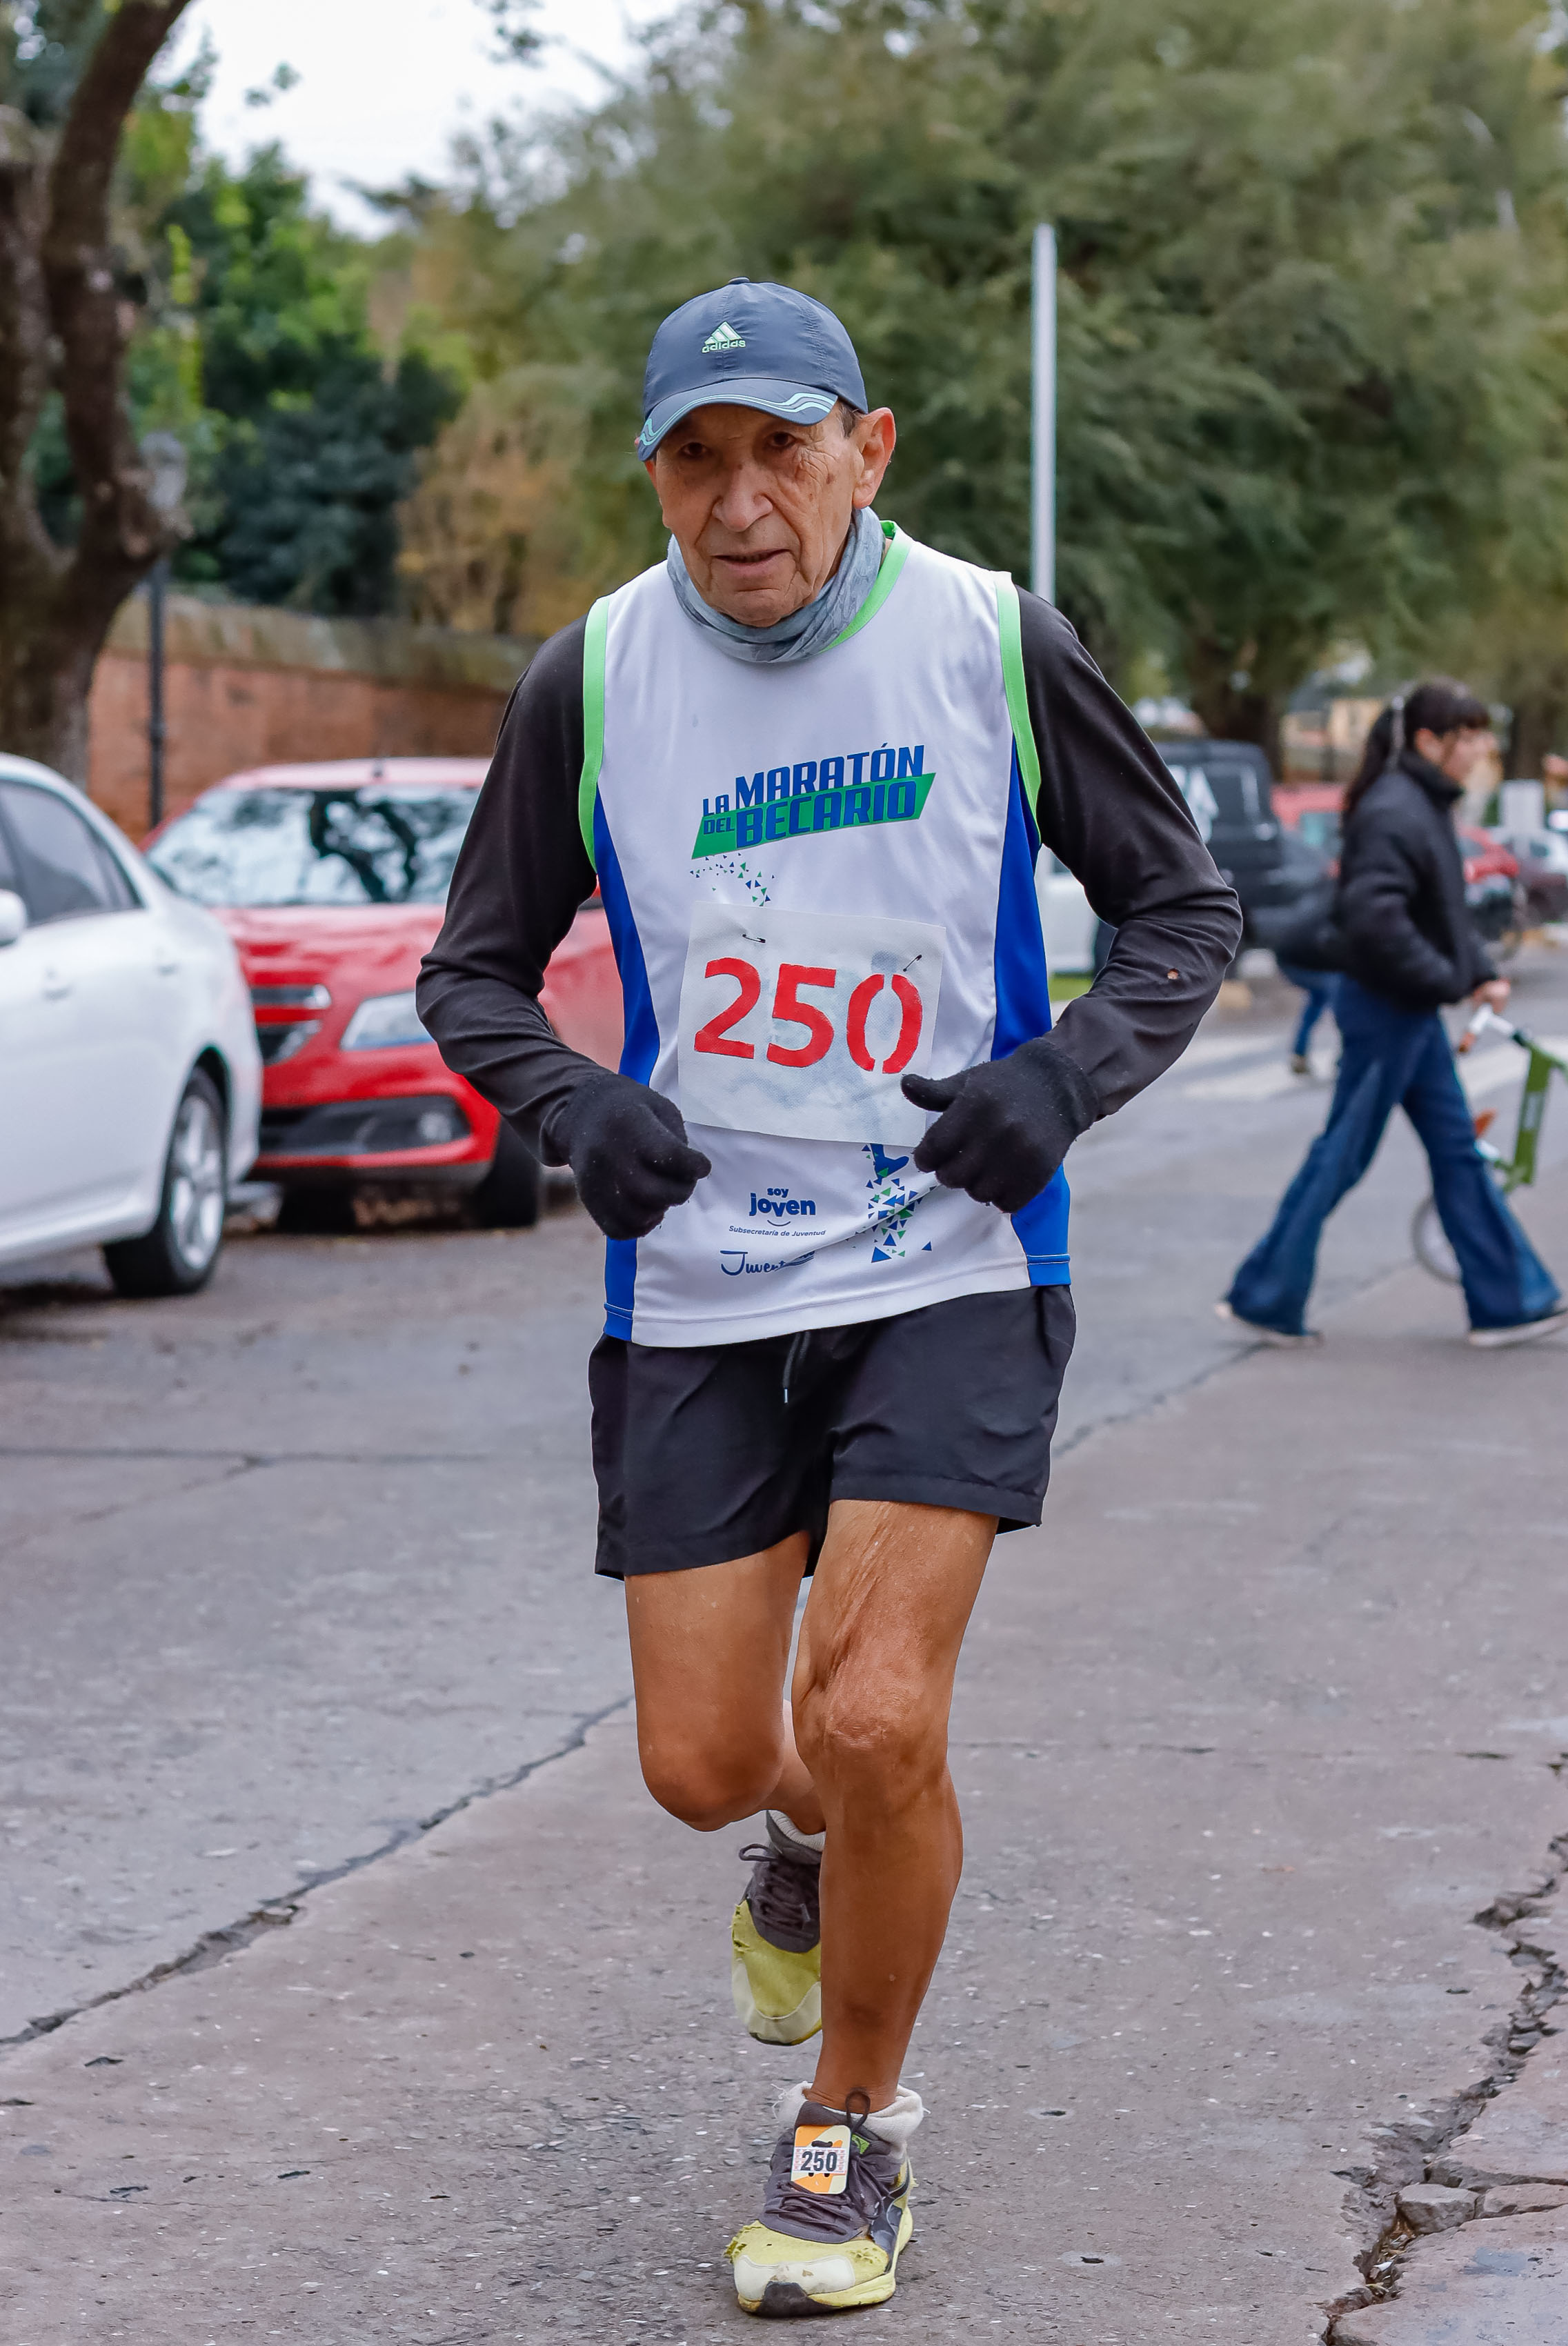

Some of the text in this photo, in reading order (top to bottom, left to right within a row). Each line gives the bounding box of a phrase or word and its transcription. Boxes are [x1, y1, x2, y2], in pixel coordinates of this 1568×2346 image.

[702, 340, 746, 353] adidas
[703, 742, 924, 817] LA MARATÓN
[703, 780, 916, 848] DEL BECARIO
[694, 957, 923, 1074] 250
[767, 1187, 788, 1197] soy
[749, 1192, 815, 1217] joven
[728, 1225, 779, 1236] Subsecretaría
[800, 2151, 837, 2171] 250
